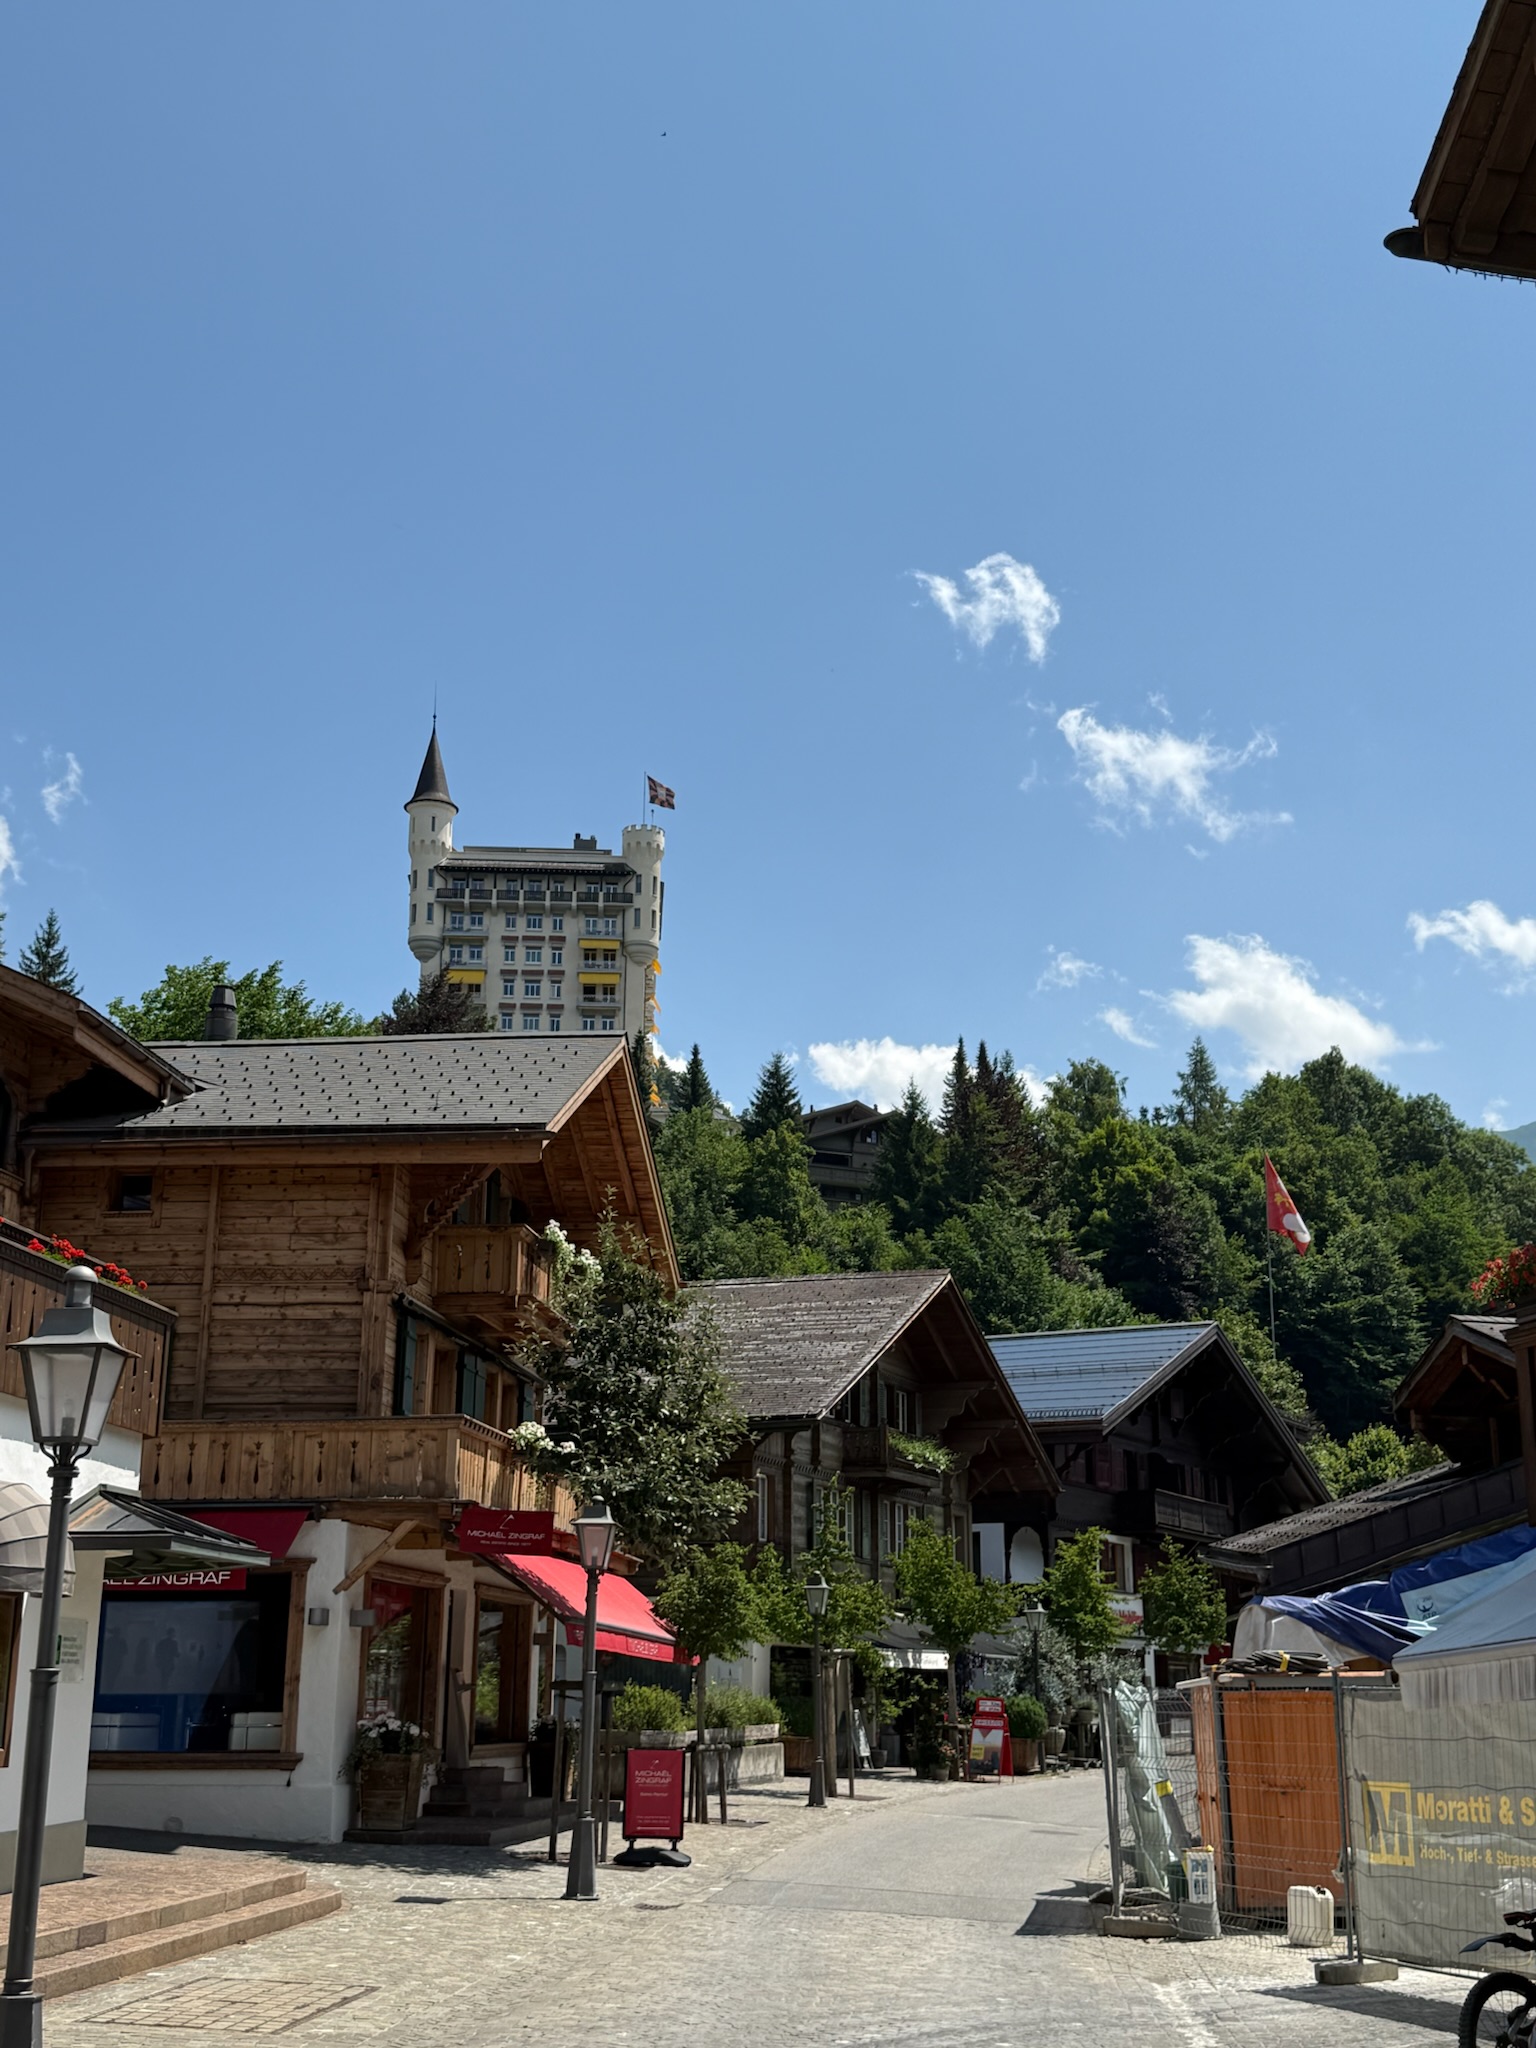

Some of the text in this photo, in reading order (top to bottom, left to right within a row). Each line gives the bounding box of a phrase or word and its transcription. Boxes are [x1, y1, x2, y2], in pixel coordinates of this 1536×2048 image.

[508, 1532, 545, 1540] ZINGRAF
[138, 1571, 231, 1585] ZINGRAF
[1416, 1792, 1492, 1824] Moratti
[1498, 1795, 1515, 1825] &
[1485, 1849, 1493, 1864] &
